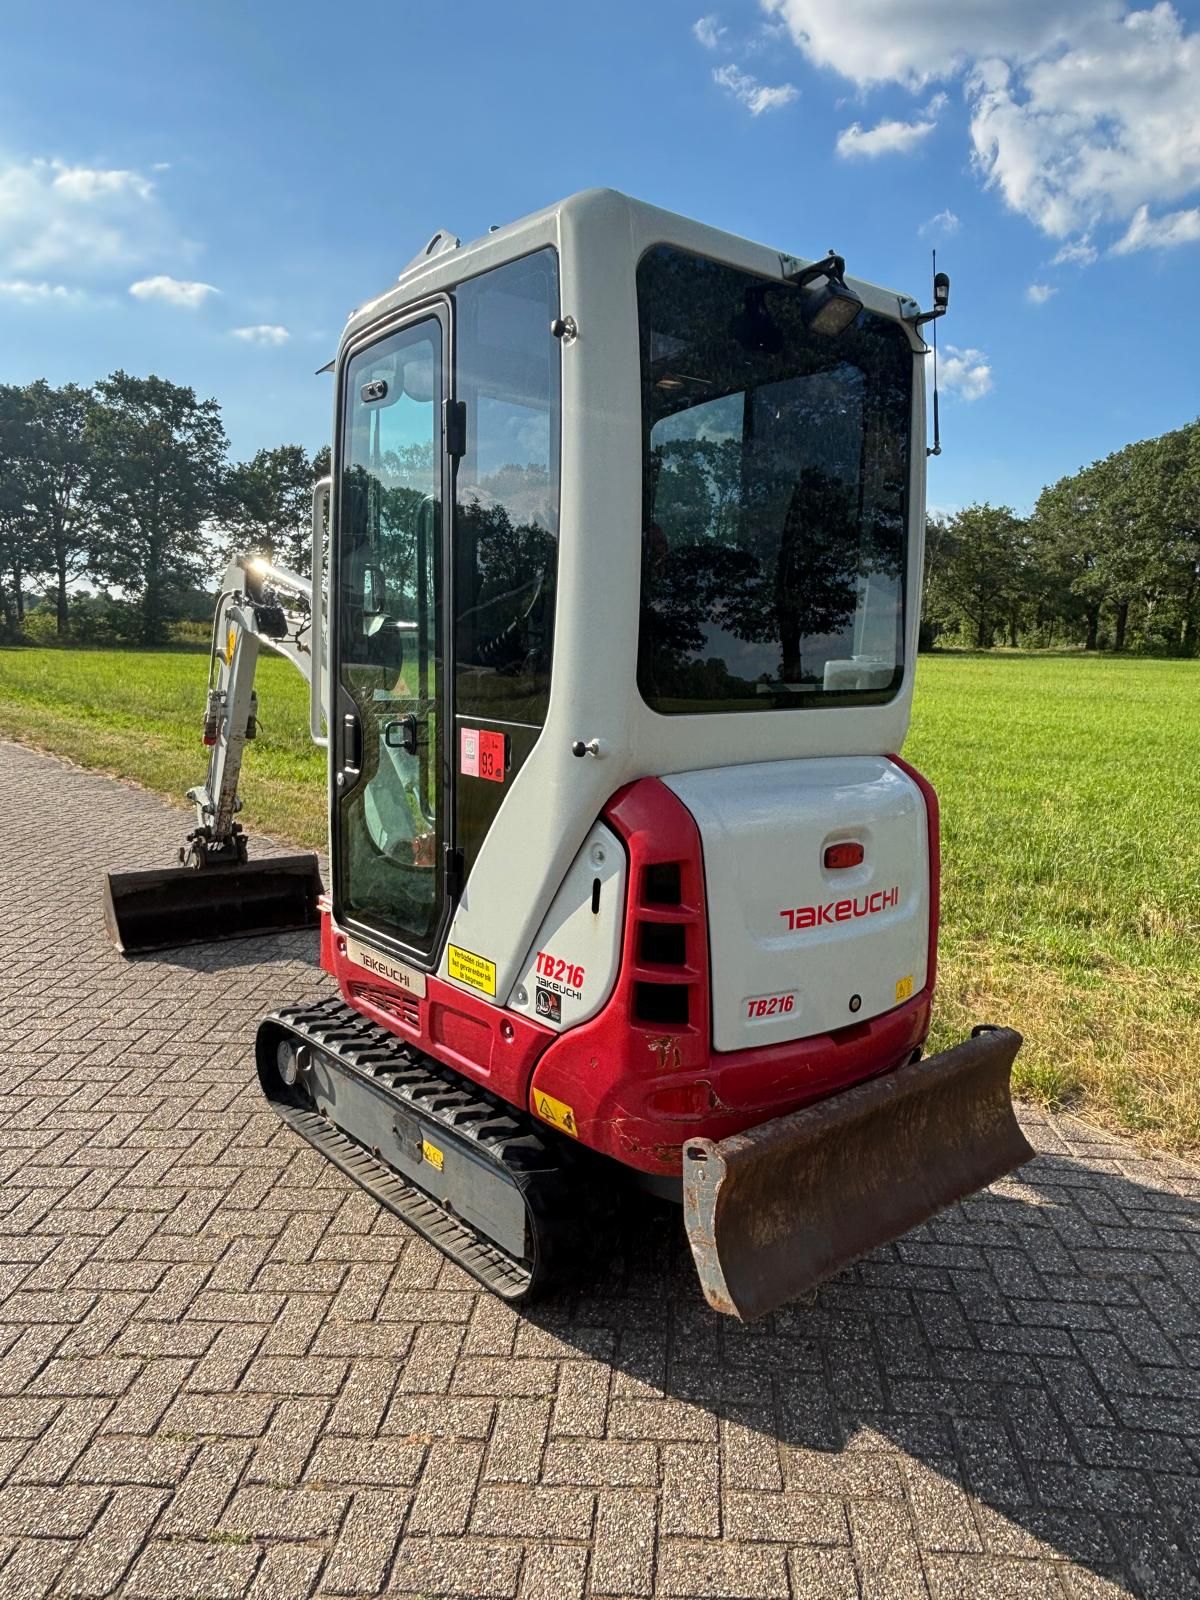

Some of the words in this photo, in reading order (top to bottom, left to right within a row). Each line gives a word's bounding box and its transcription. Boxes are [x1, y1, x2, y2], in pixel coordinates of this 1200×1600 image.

[482, 751, 493, 776] 93
[779, 886, 899, 930] TAKEUCHI
[536, 951, 585, 988] TB216
[748, 995, 794, 1018] TB216
